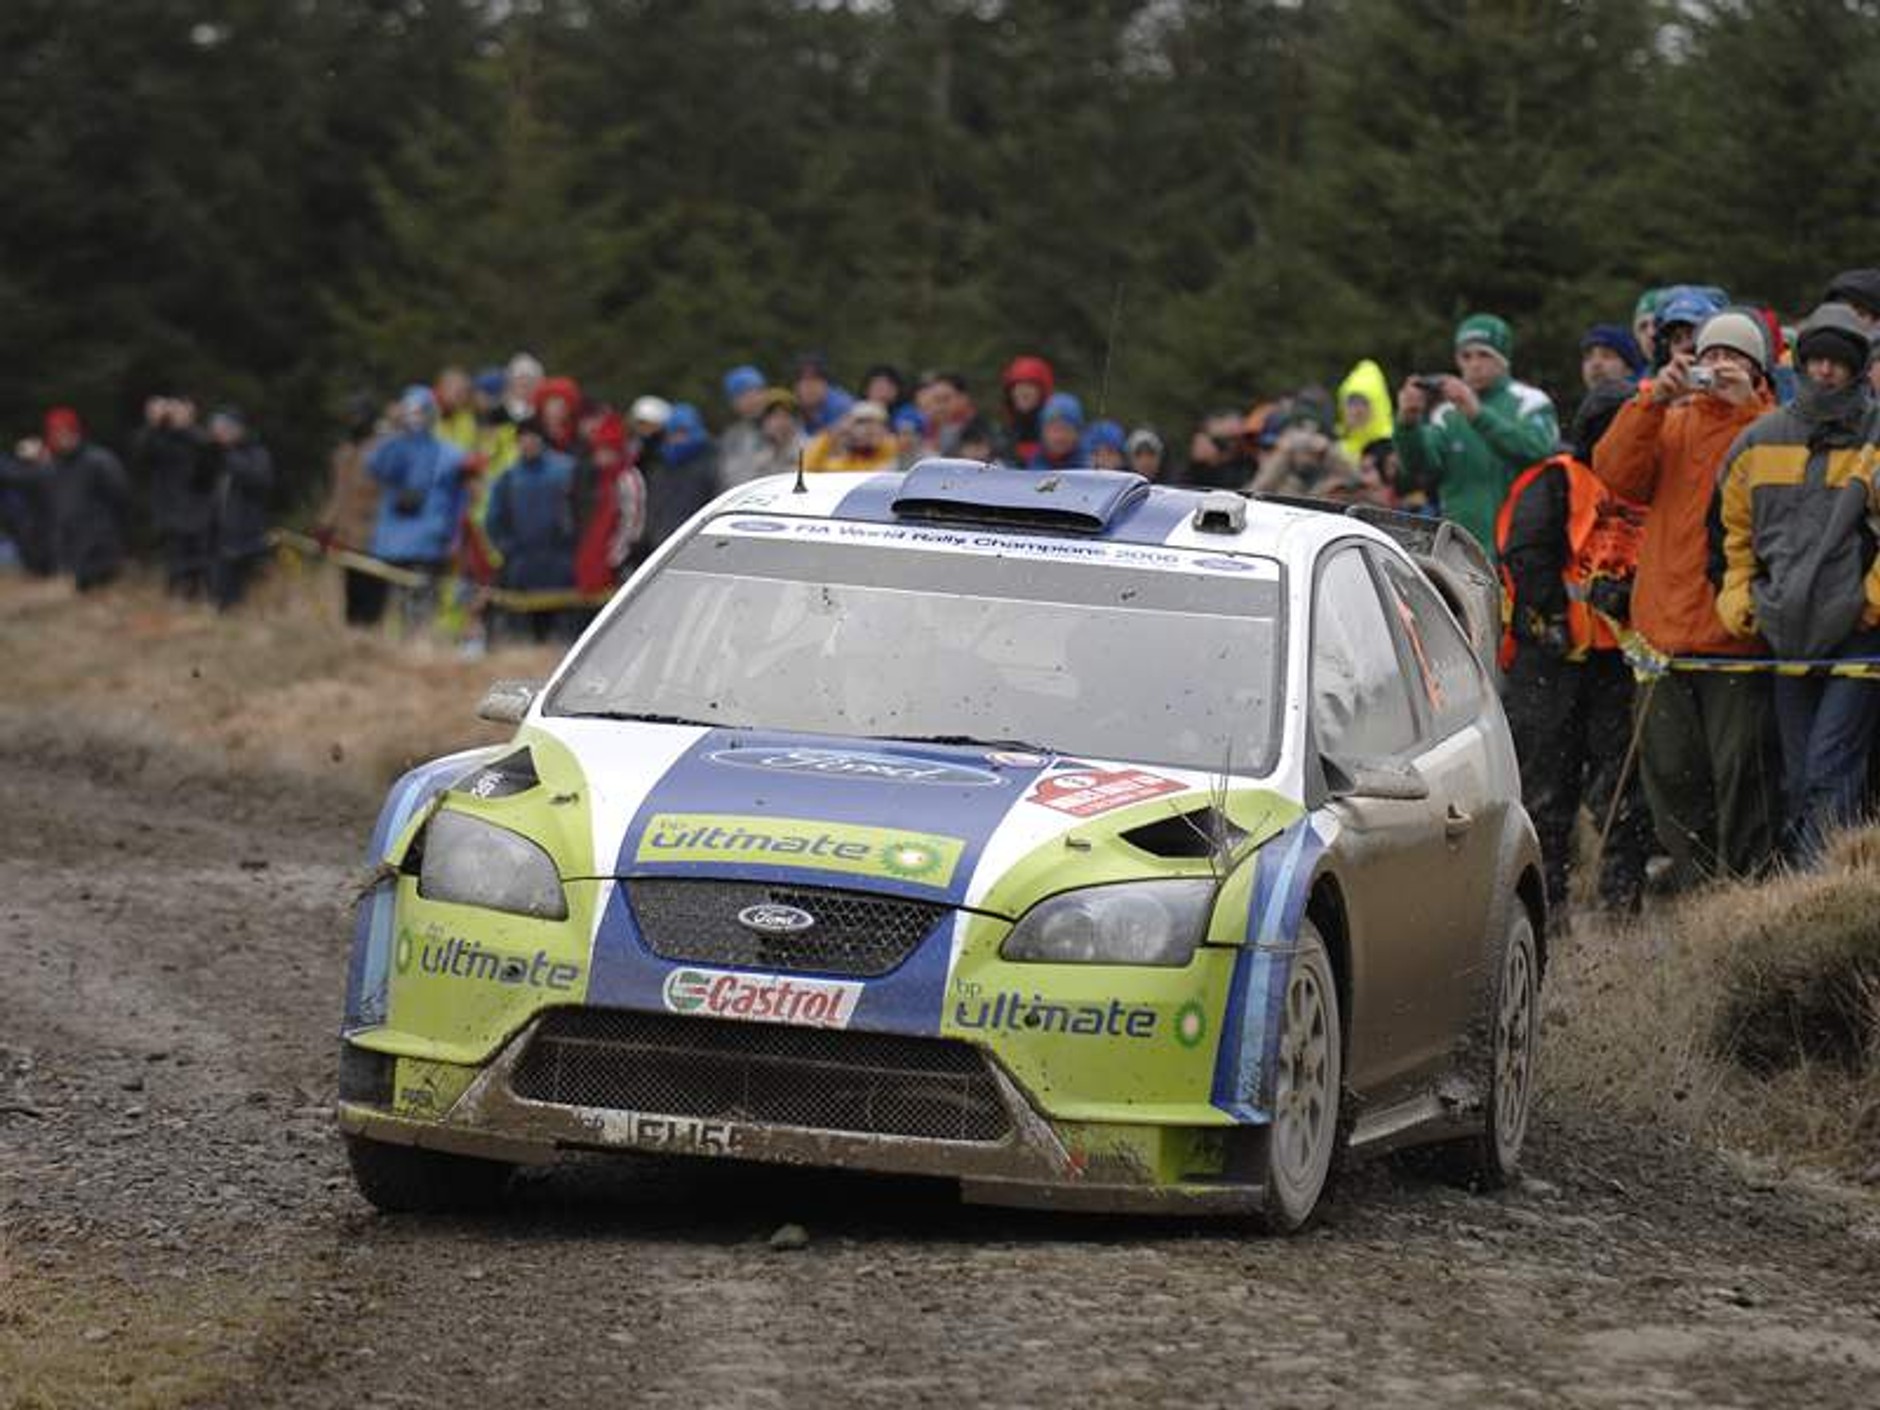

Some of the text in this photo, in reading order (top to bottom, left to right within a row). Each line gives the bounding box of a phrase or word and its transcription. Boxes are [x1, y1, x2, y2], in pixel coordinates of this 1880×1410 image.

[795, 524, 830, 535] FIA
[837, 526, 904, 541] World
[911, 531, 967, 547] Rally
[971, 536, 1106, 558] Champions
[651, 826, 871, 861] ultimate
[752, 905, 799, 926] Ford
[421, 937, 579, 991] ultimate
[707, 974, 846, 1022] Castrol
[956, 977, 982, 998] bp
[954, 993, 1157, 1038] ultimate
